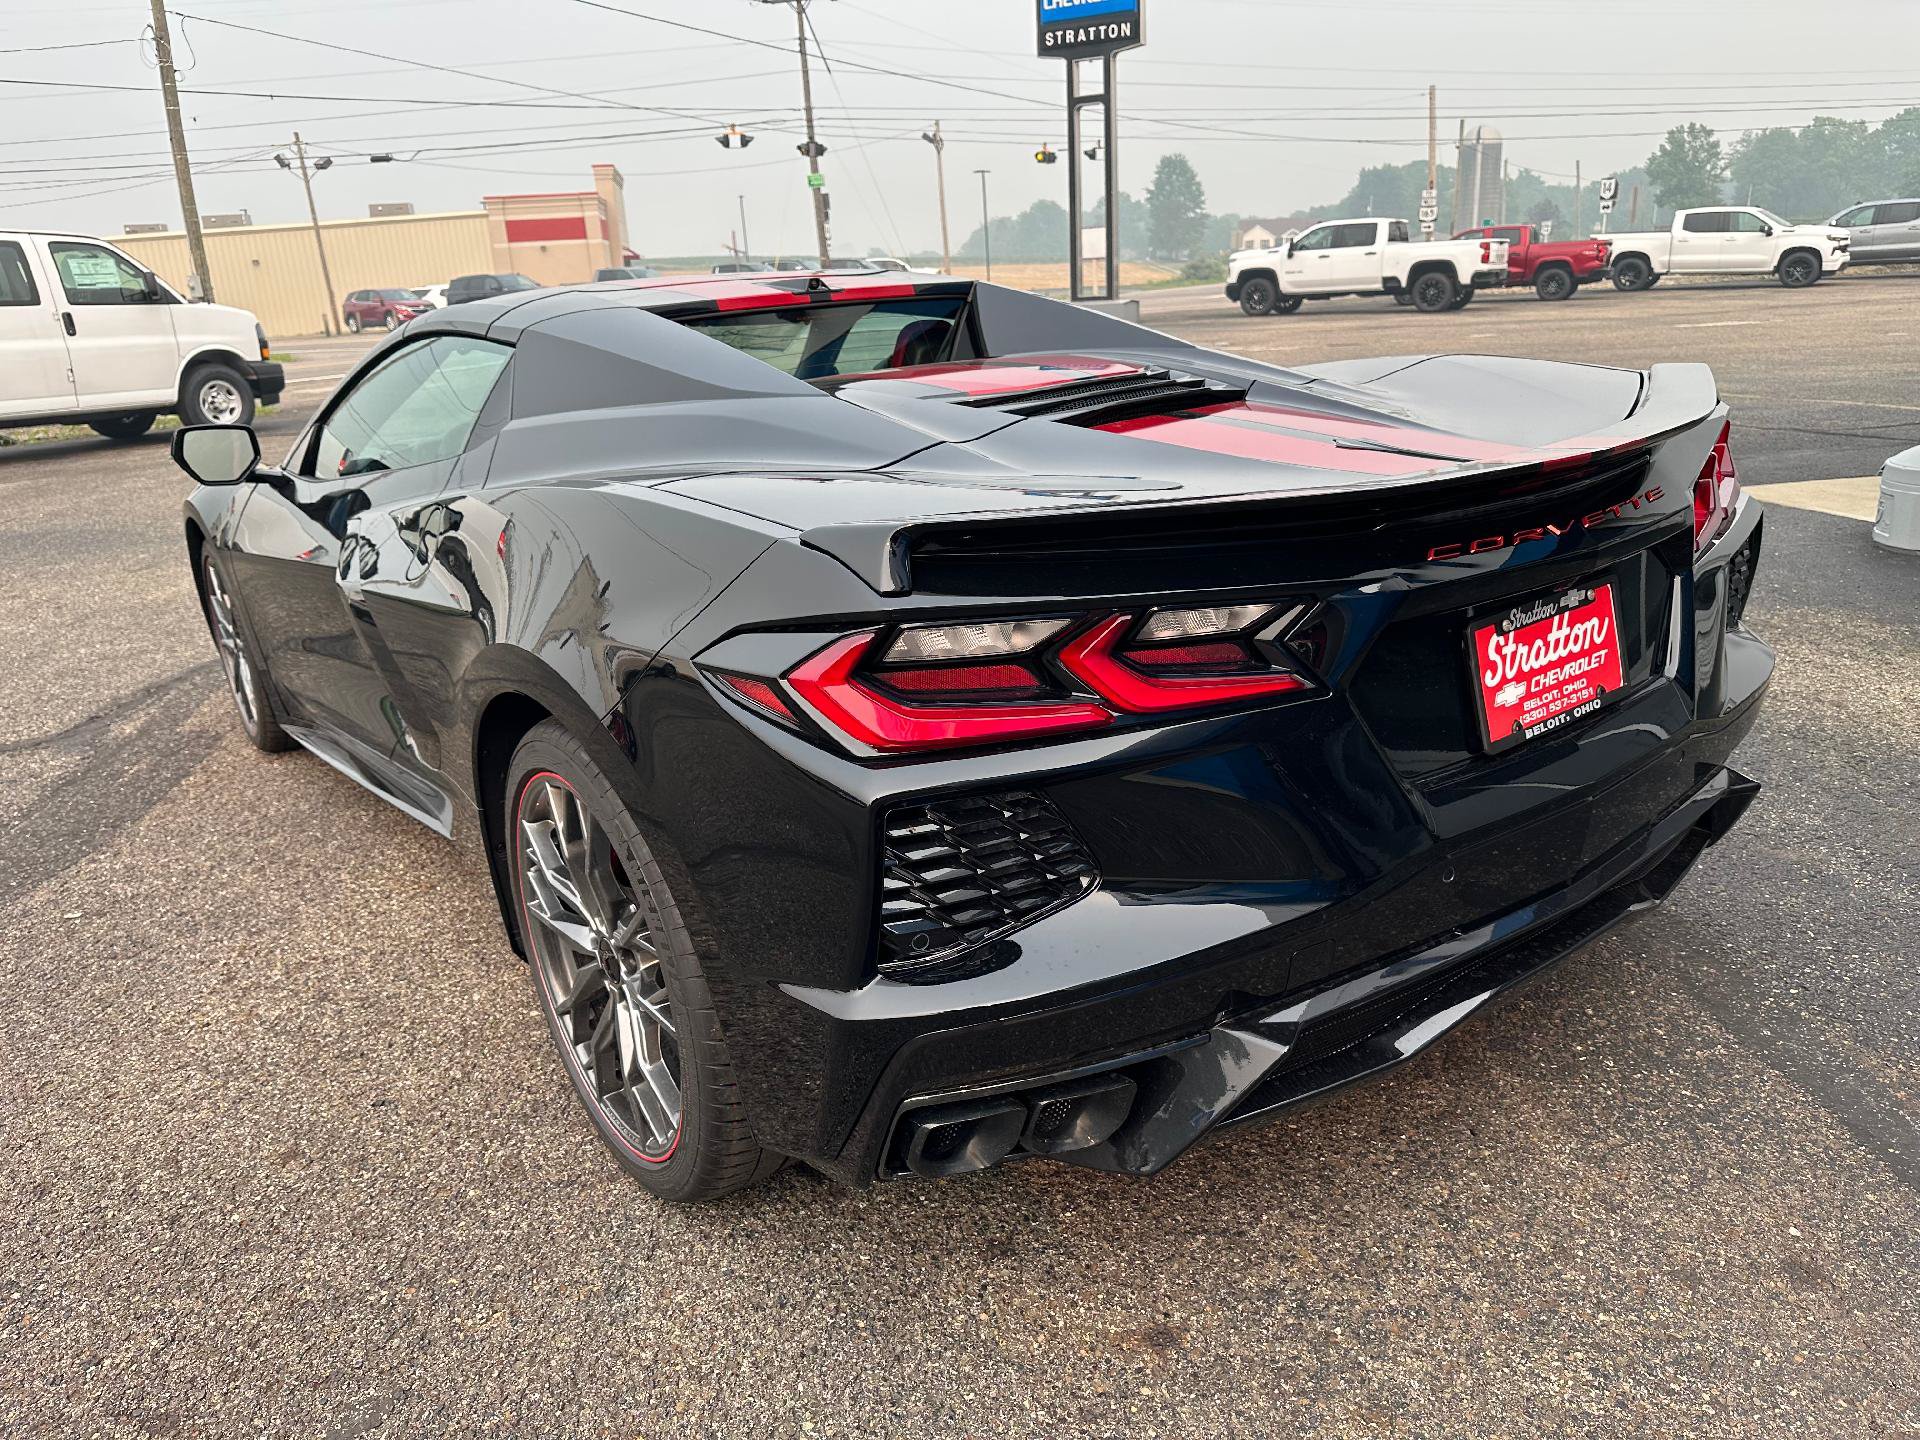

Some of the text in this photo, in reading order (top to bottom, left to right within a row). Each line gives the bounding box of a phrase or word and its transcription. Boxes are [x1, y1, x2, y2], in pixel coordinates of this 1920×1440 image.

[1045, 22, 1131, 46] STRATTON
[1427, 486, 1665, 561] CORVETTE
[1510, 600, 1558, 630] Stratton
[1484, 611, 1609, 688] Stratton
[1530, 649, 1609, 692] CHEVROLET
[1519, 687, 1594, 724] (330) 537-3151
[1523, 678, 1587, 711] BELOIT, OHIO
[1525, 699, 1602, 740] BELOIT, OHIO
